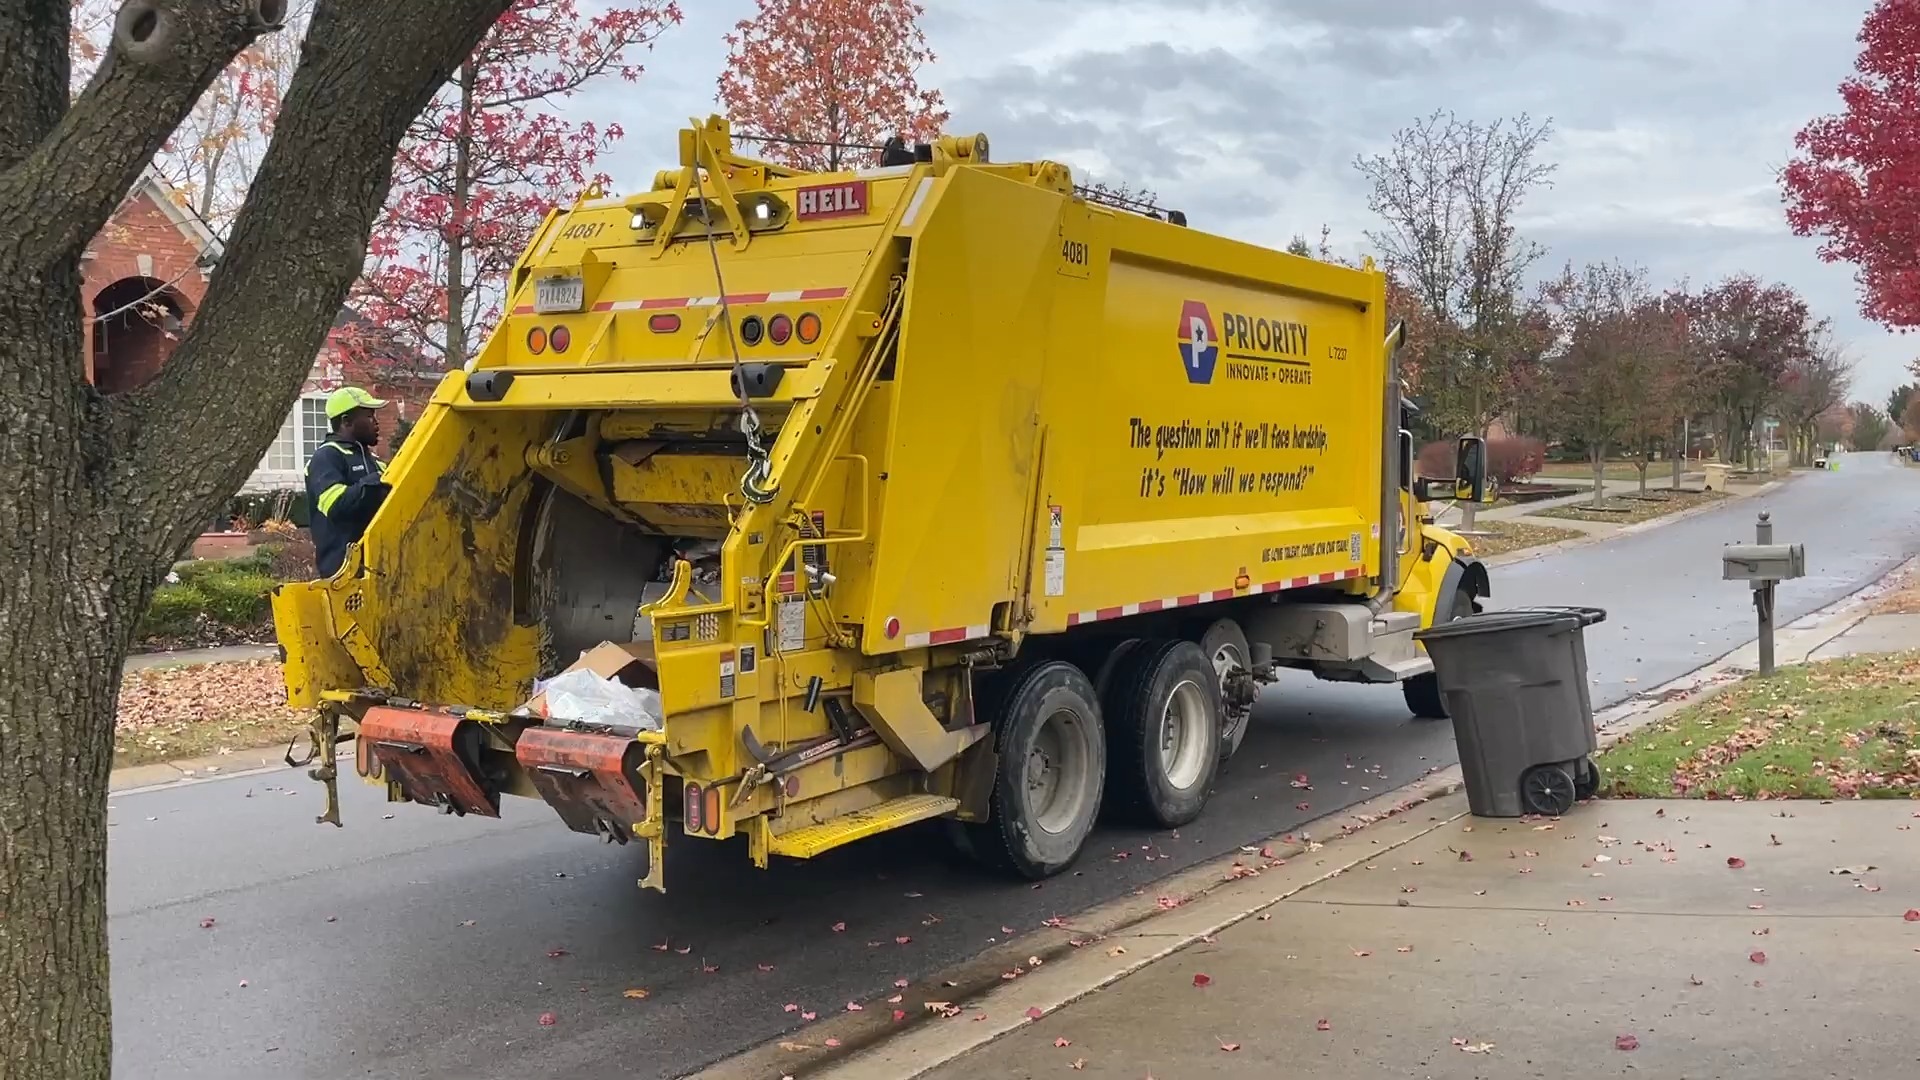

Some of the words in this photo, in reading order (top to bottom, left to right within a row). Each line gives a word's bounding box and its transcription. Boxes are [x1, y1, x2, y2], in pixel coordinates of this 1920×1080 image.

[799, 187, 860, 213] HEIL
[562, 222, 606, 239] 4081
[1062, 240, 1089, 266] 4081
[1189, 316, 1209, 368] P
[1223, 312, 1308, 356] PRIORITY
[1226, 362, 1269, 381] INNOVATE
[1278, 368, 1311, 385] OPERATE
[1129, 417, 1151, 449] The
[1156, 418, 1202, 461] question
[1205, 419, 1229, 449] isn't
[1232, 420, 1243, 449] if
[1245, 422, 1268, 449] we'll
[1271, 422, 1290, 449] face
[1293, 423, 1328, 456] hardship,
[1140, 467, 1165, 497] it's
[1172, 467, 1207, 496] "How
[1212, 466, 1235, 495] will
[1239, 472, 1255, 493] we
[1258, 464, 1314, 497] respond?"
